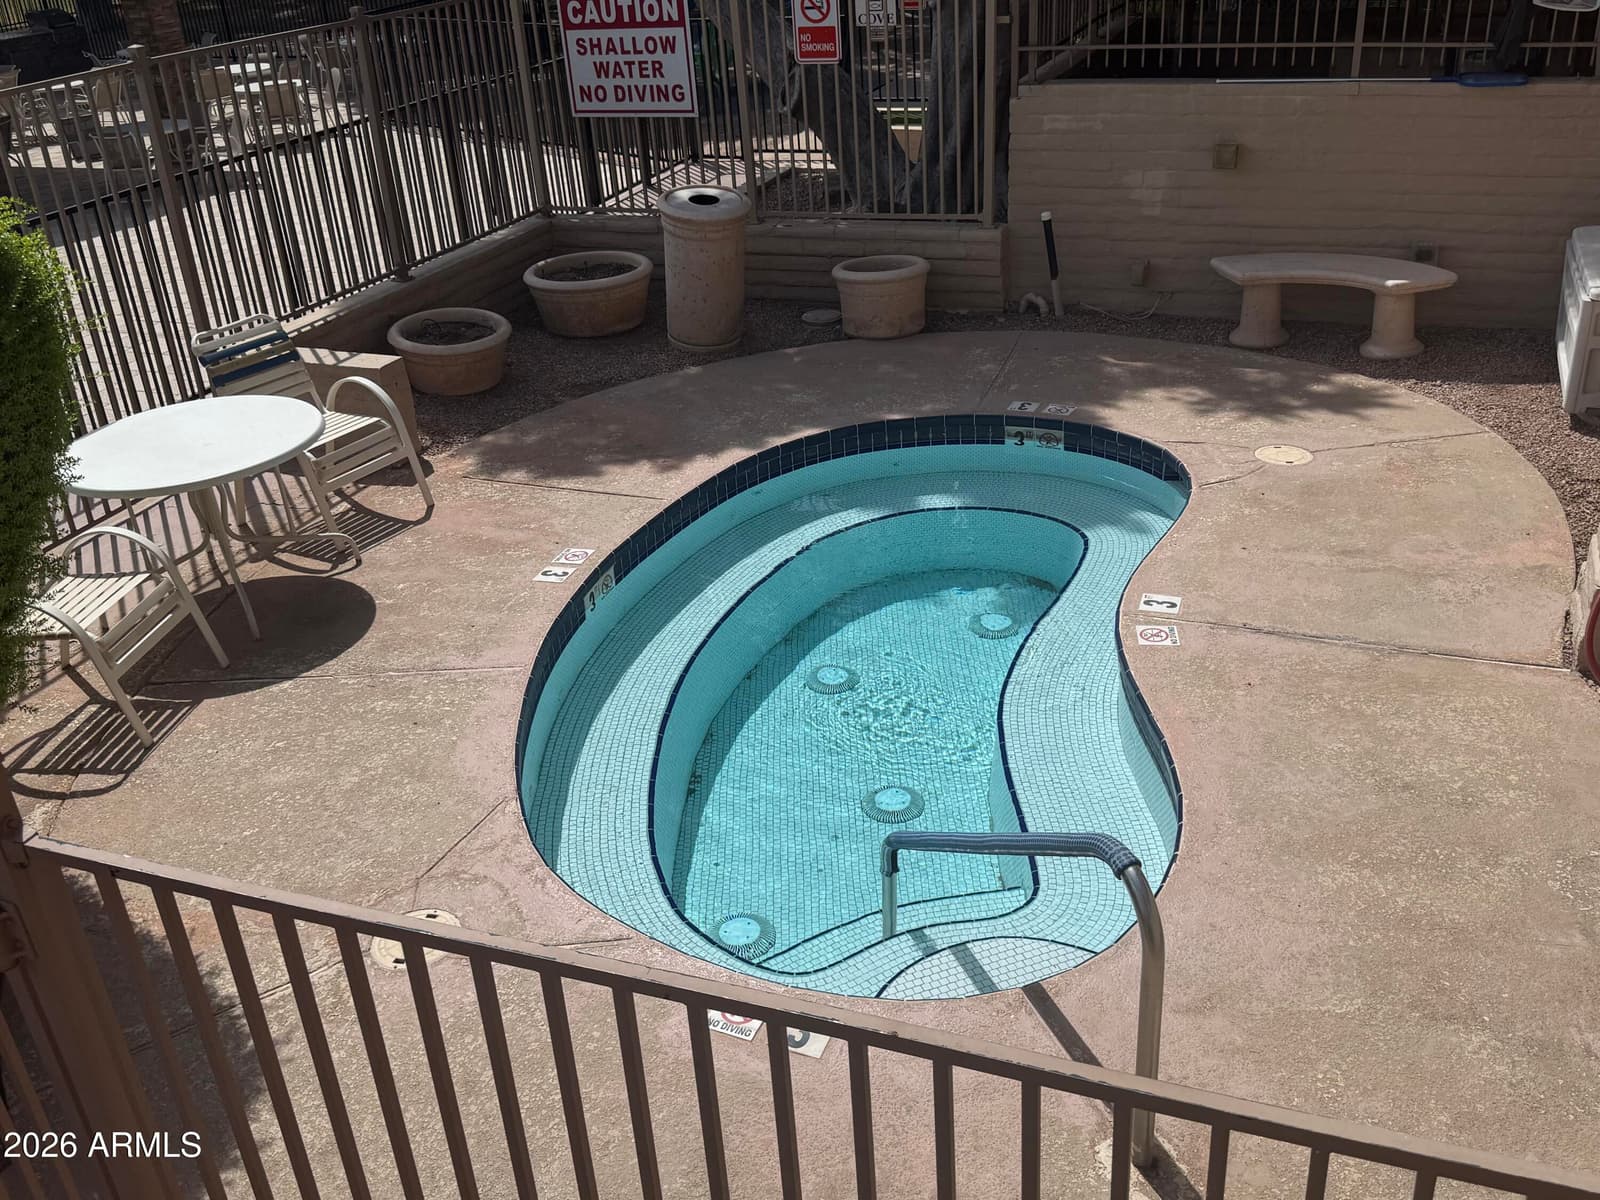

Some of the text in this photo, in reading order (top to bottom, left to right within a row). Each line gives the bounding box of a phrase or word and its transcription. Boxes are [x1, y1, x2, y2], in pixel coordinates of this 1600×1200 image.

[567, 0, 679, 24] CAUTION
[800, 33, 811, 42] NO
[575, 35, 676, 56] SHALLOW
[801, 42, 835, 52] SMOKING
[593, 60, 665, 79] WATER
[579, 84, 685, 103] NO DIVING
[1018, 402, 1032, 411] 3
[540, 569, 569, 578] 3
[1143, 600, 1178, 609] 3
[720, 1022, 752, 1037] DIVING
